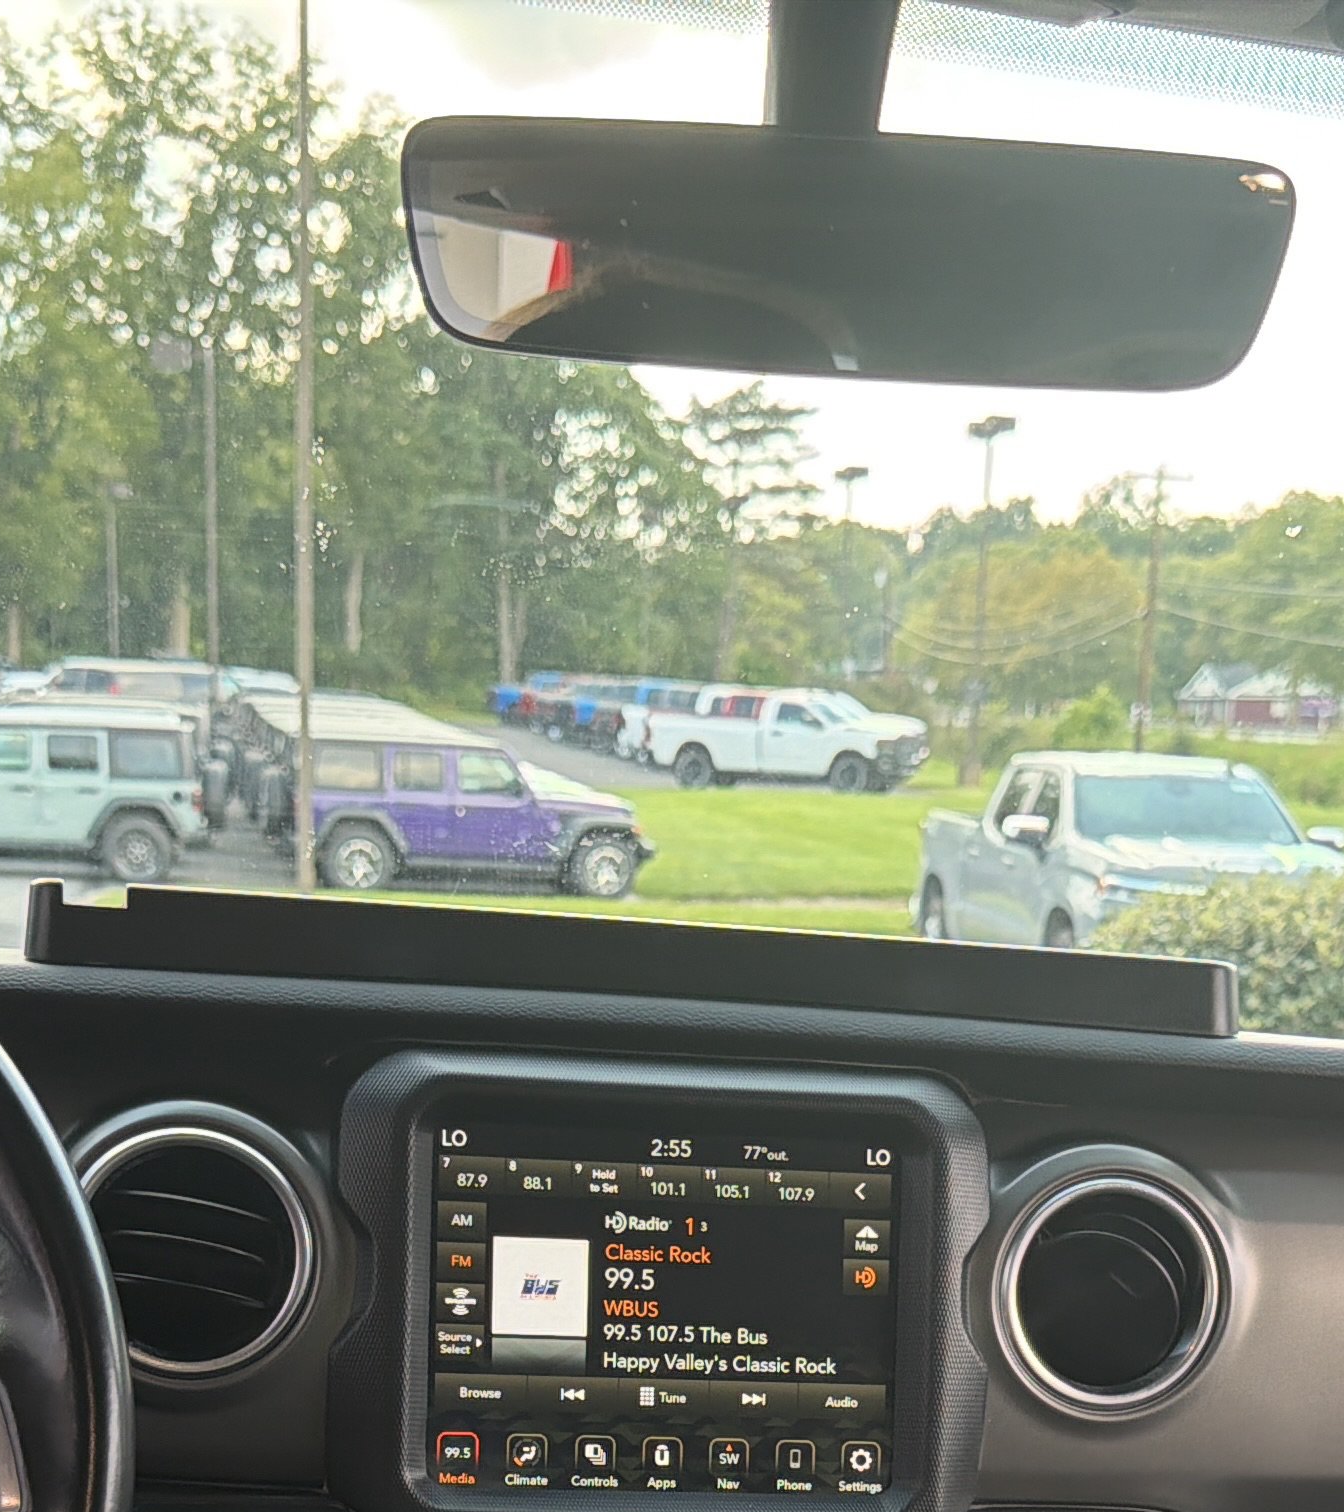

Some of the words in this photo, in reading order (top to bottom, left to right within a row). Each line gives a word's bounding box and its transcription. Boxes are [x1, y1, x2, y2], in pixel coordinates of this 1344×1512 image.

[442, 1130, 467, 1147] LO
[650, 1139, 692, 1158] 2:55
[442, 1158, 451, 1168] 7
[866, 1148, 891, 1166] LO
[509, 1160, 517, 1171] 8
[574, 1163, 582, 1174] 9
[640, 1166, 653, 1177] 10
[457, 1173, 488, 1188] 87.9
[591, 1169, 616, 1181] Hold
[705, 1169, 717, 1180] 11
[768, 1171, 781, 1183] 12
[523, 1176, 552, 1191] 88.1
[590, 1183, 600, 1193] to
[602, 1183, 618, 1194] Set
[650, 1182, 686, 1195] 101.1
[714, 1184, 750, 1198] 105.1
[778, 1186, 814, 1201] 107.9
[451, 1214, 473, 1227] AM
[628, 1216, 672, 1233] Radio
[685, 1217, 695, 1236] 1
[700, 1222, 708, 1232] 3
[855, 1240, 879, 1253] Map
[605, 1244, 663, 1263] Classic
[669, 1245, 711, 1264] Rock
[451, 1255, 472, 1268] FM
[604, 1268, 655, 1291] 99.5
[604, 1299, 659, 1318] WBUS
[437, 1331, 472, 1344] Source
[603, 1324, 643, 1342] 99.5
[647, 1325, 695, 1343] 107.5
[699, 1326, 731, 1344] The
[736, 1327, 768, 1345] Bus
[439, 1343, 471, 1356] Select
[603, 1352, 660, 1374] Happy
[664, 1354, 728, 1374] Valley's
[732, 1356, 791, 1374] Classic
[795, 1357, 836, 1375] Rock
[459, 1386, 502, 1400] Browse
[659, 1391, 687, 1405] Tune
[825, 1396, 858, 1409] Audio
[444, 1446, 471, 1460] 99.5
[719, 1451, 740, 1466] SW
[439, 1472, 476, 1486] Media
[504, 1474, 549, 1487] Climate
[570, 1475, 619, 1489] Controls
[647, 1476, 676, 1492] Apps
[717, 1478, 740, 1491] Nav
[776, 1479, 812, 1493] Phone
[838, 1480, 883, 1496] Settings
